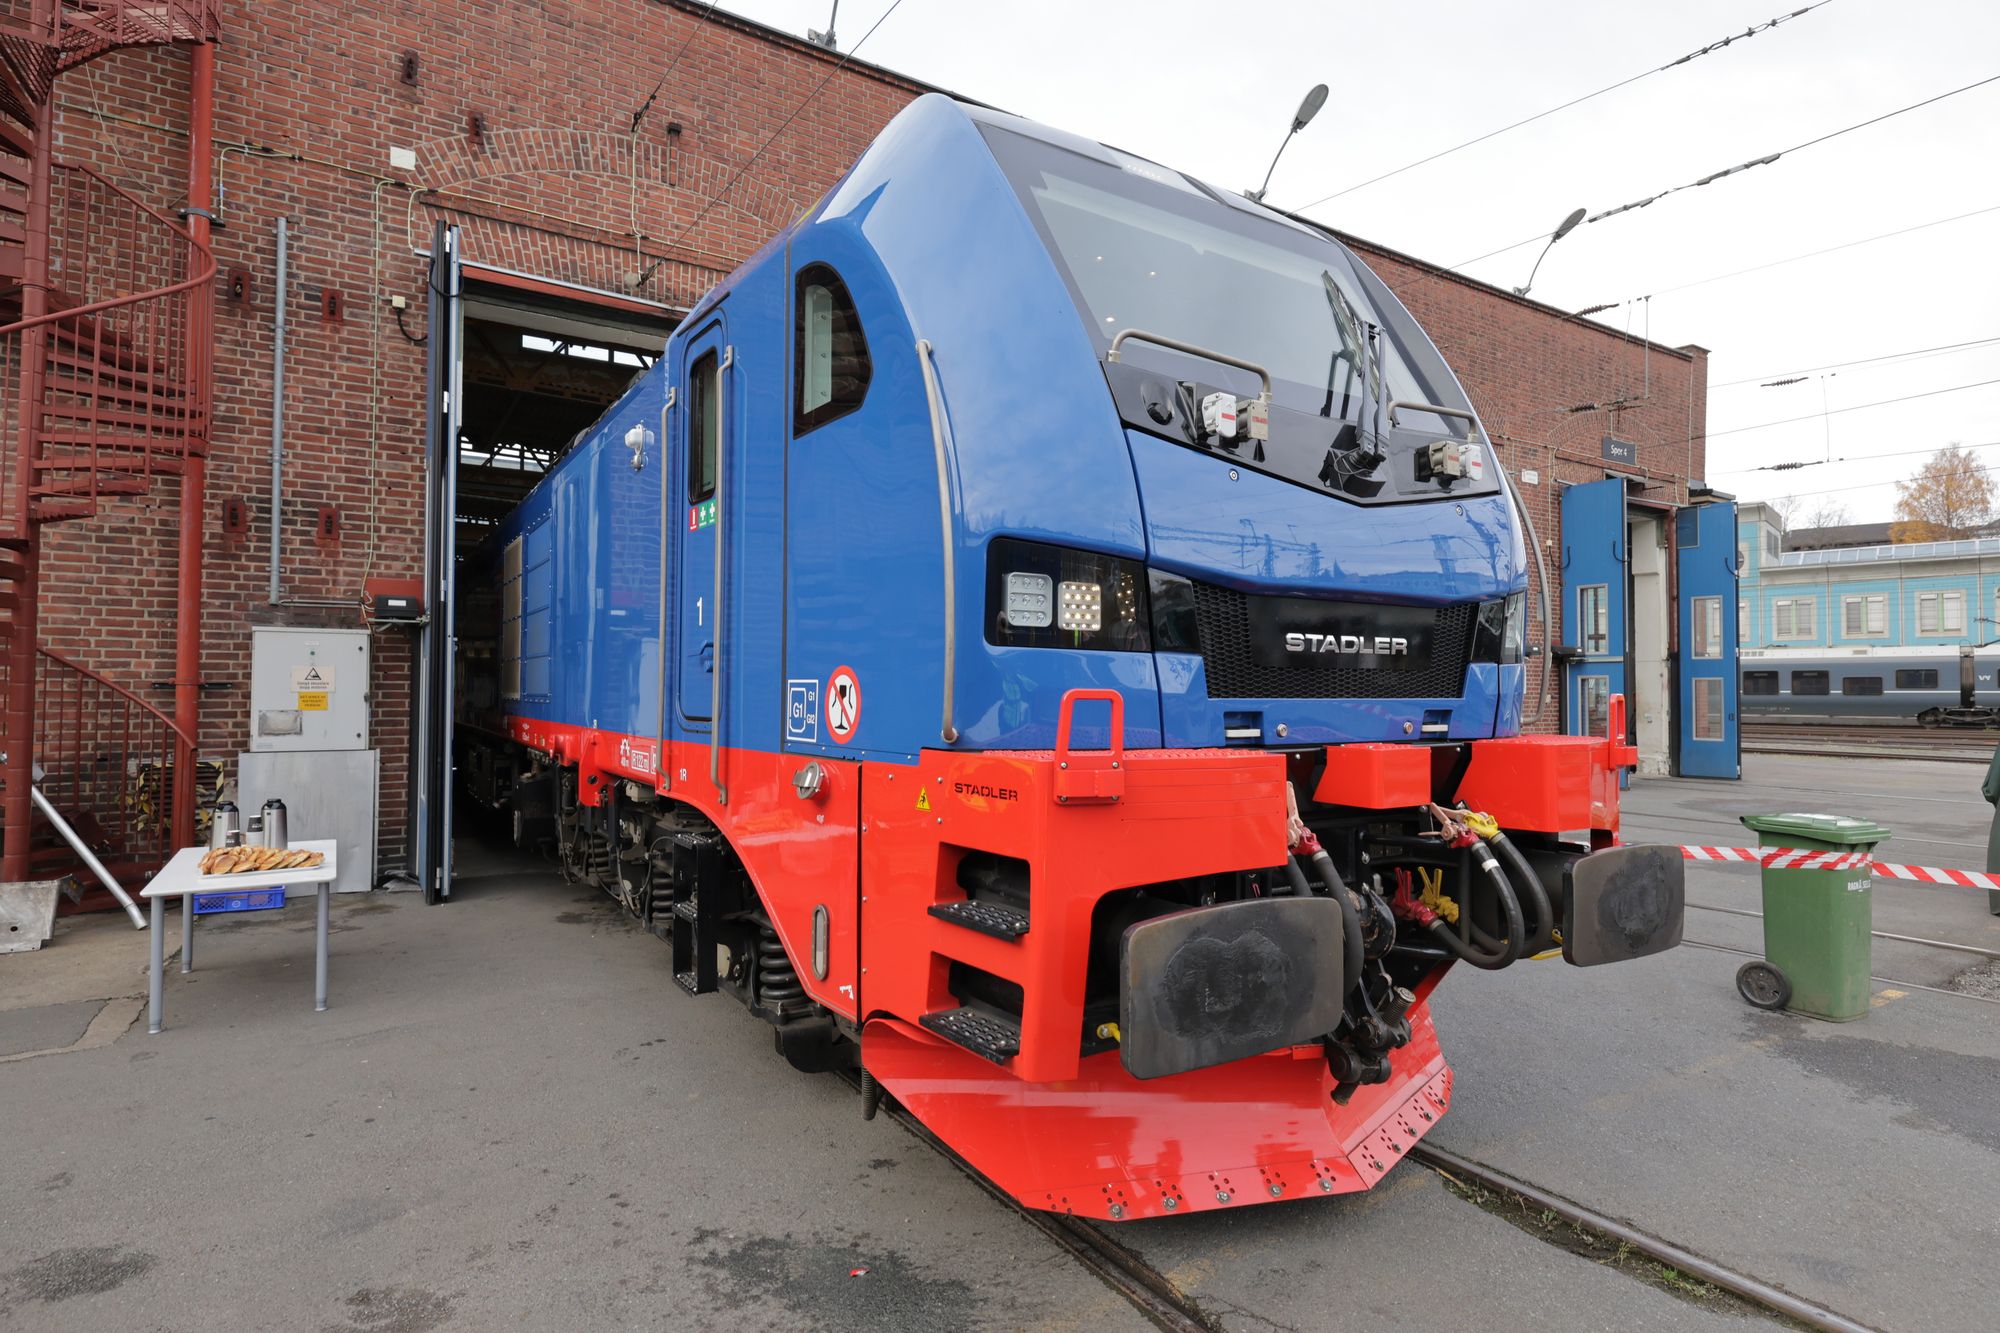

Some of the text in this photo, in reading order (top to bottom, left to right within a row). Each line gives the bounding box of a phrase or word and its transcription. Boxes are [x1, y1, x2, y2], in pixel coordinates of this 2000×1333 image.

[1611, 444, 1623, 456] Spor
[1285, 632, 1408, 655] STADLER
[808, 691, 815, 701] G1
[793, 702, 804, 718] G1
[954, 782, 1018, 801] STADLER
